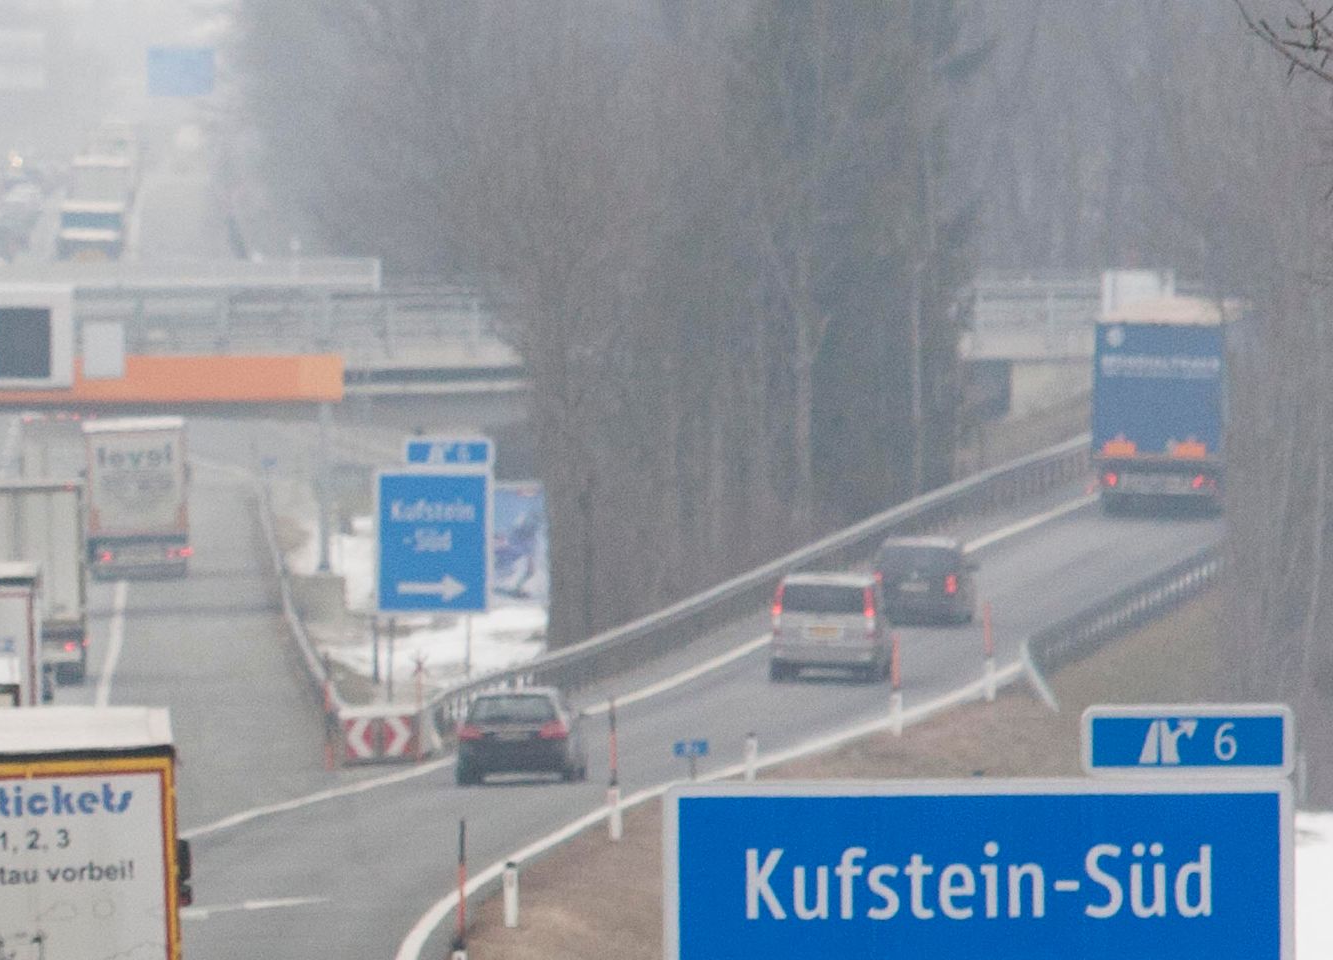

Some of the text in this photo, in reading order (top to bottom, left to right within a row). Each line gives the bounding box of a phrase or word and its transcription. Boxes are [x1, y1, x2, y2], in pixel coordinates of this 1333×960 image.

[391, 500, 475, 521] Kufstein
[1214, 722, 1237, 761] 6
[57, 828, 71, 849] 3
[46, 860, 134, 882] vorbei!
[745, 841, 1213, 920] Kufstein-Süd
